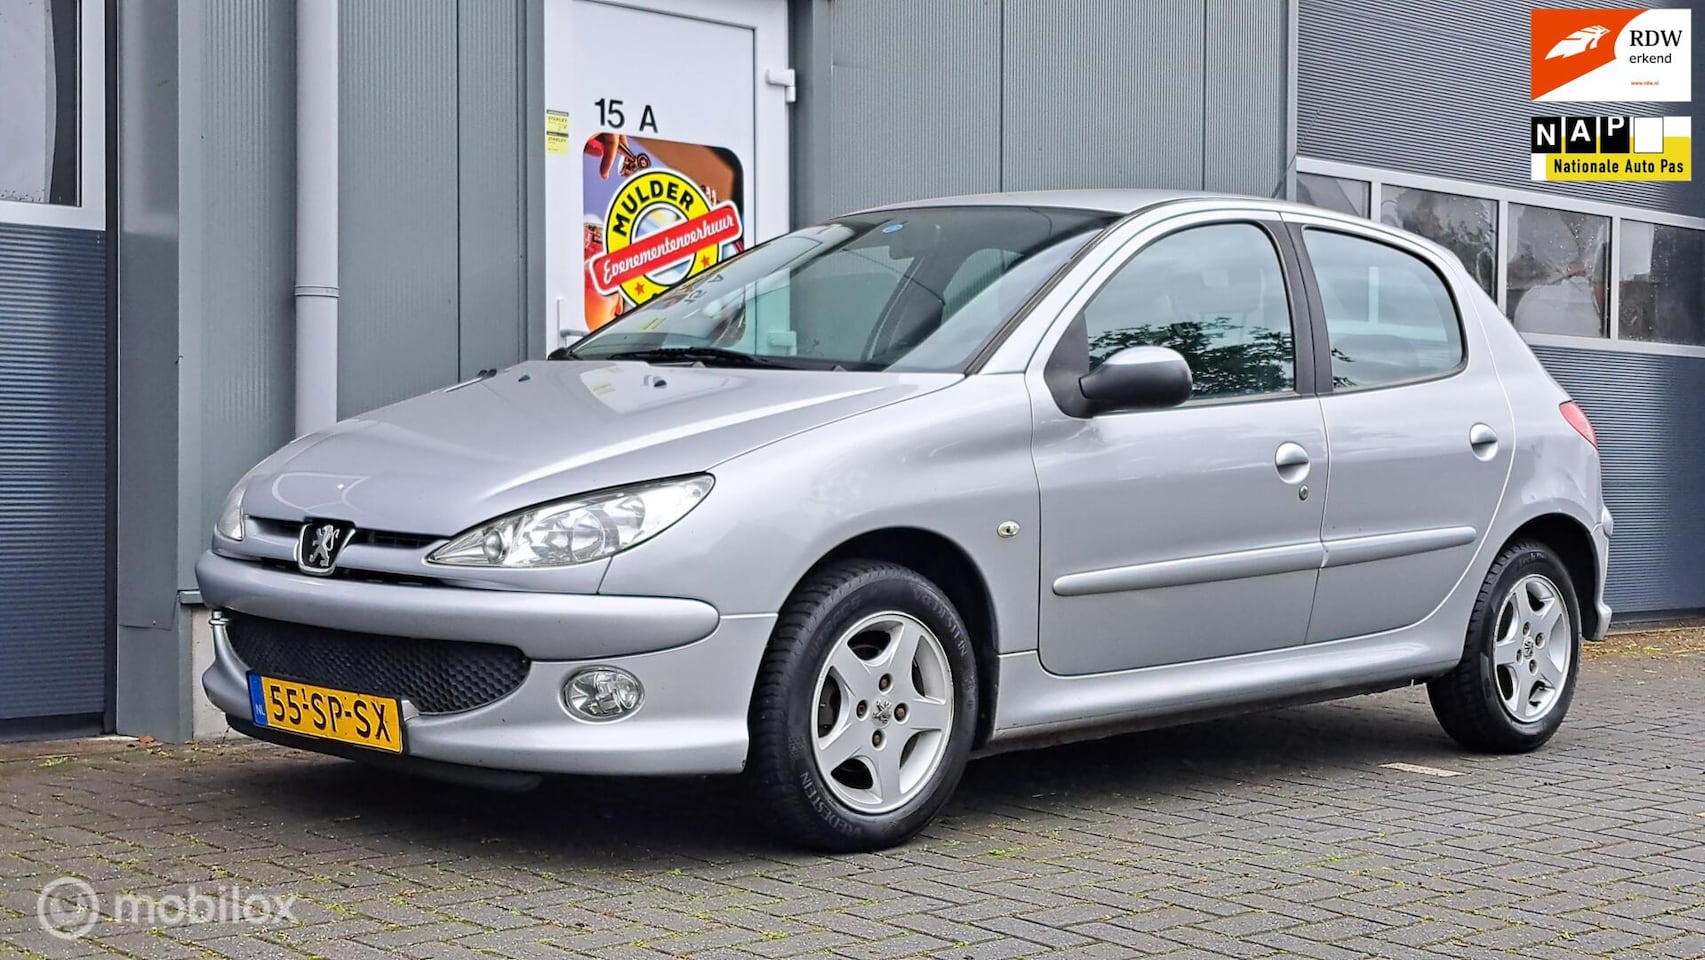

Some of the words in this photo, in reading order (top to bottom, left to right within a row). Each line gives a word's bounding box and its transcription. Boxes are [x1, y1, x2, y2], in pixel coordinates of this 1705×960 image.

[594, 97, 625, 129] 15
[639, 104, 659, 133] A
[612, 179, 695, 237] MULDER
[602, 214, 735, 284] Evenementenverhuur
[255, 703, 266, 716] NL
[269, 685, 392, 743] 55-SP-SX
